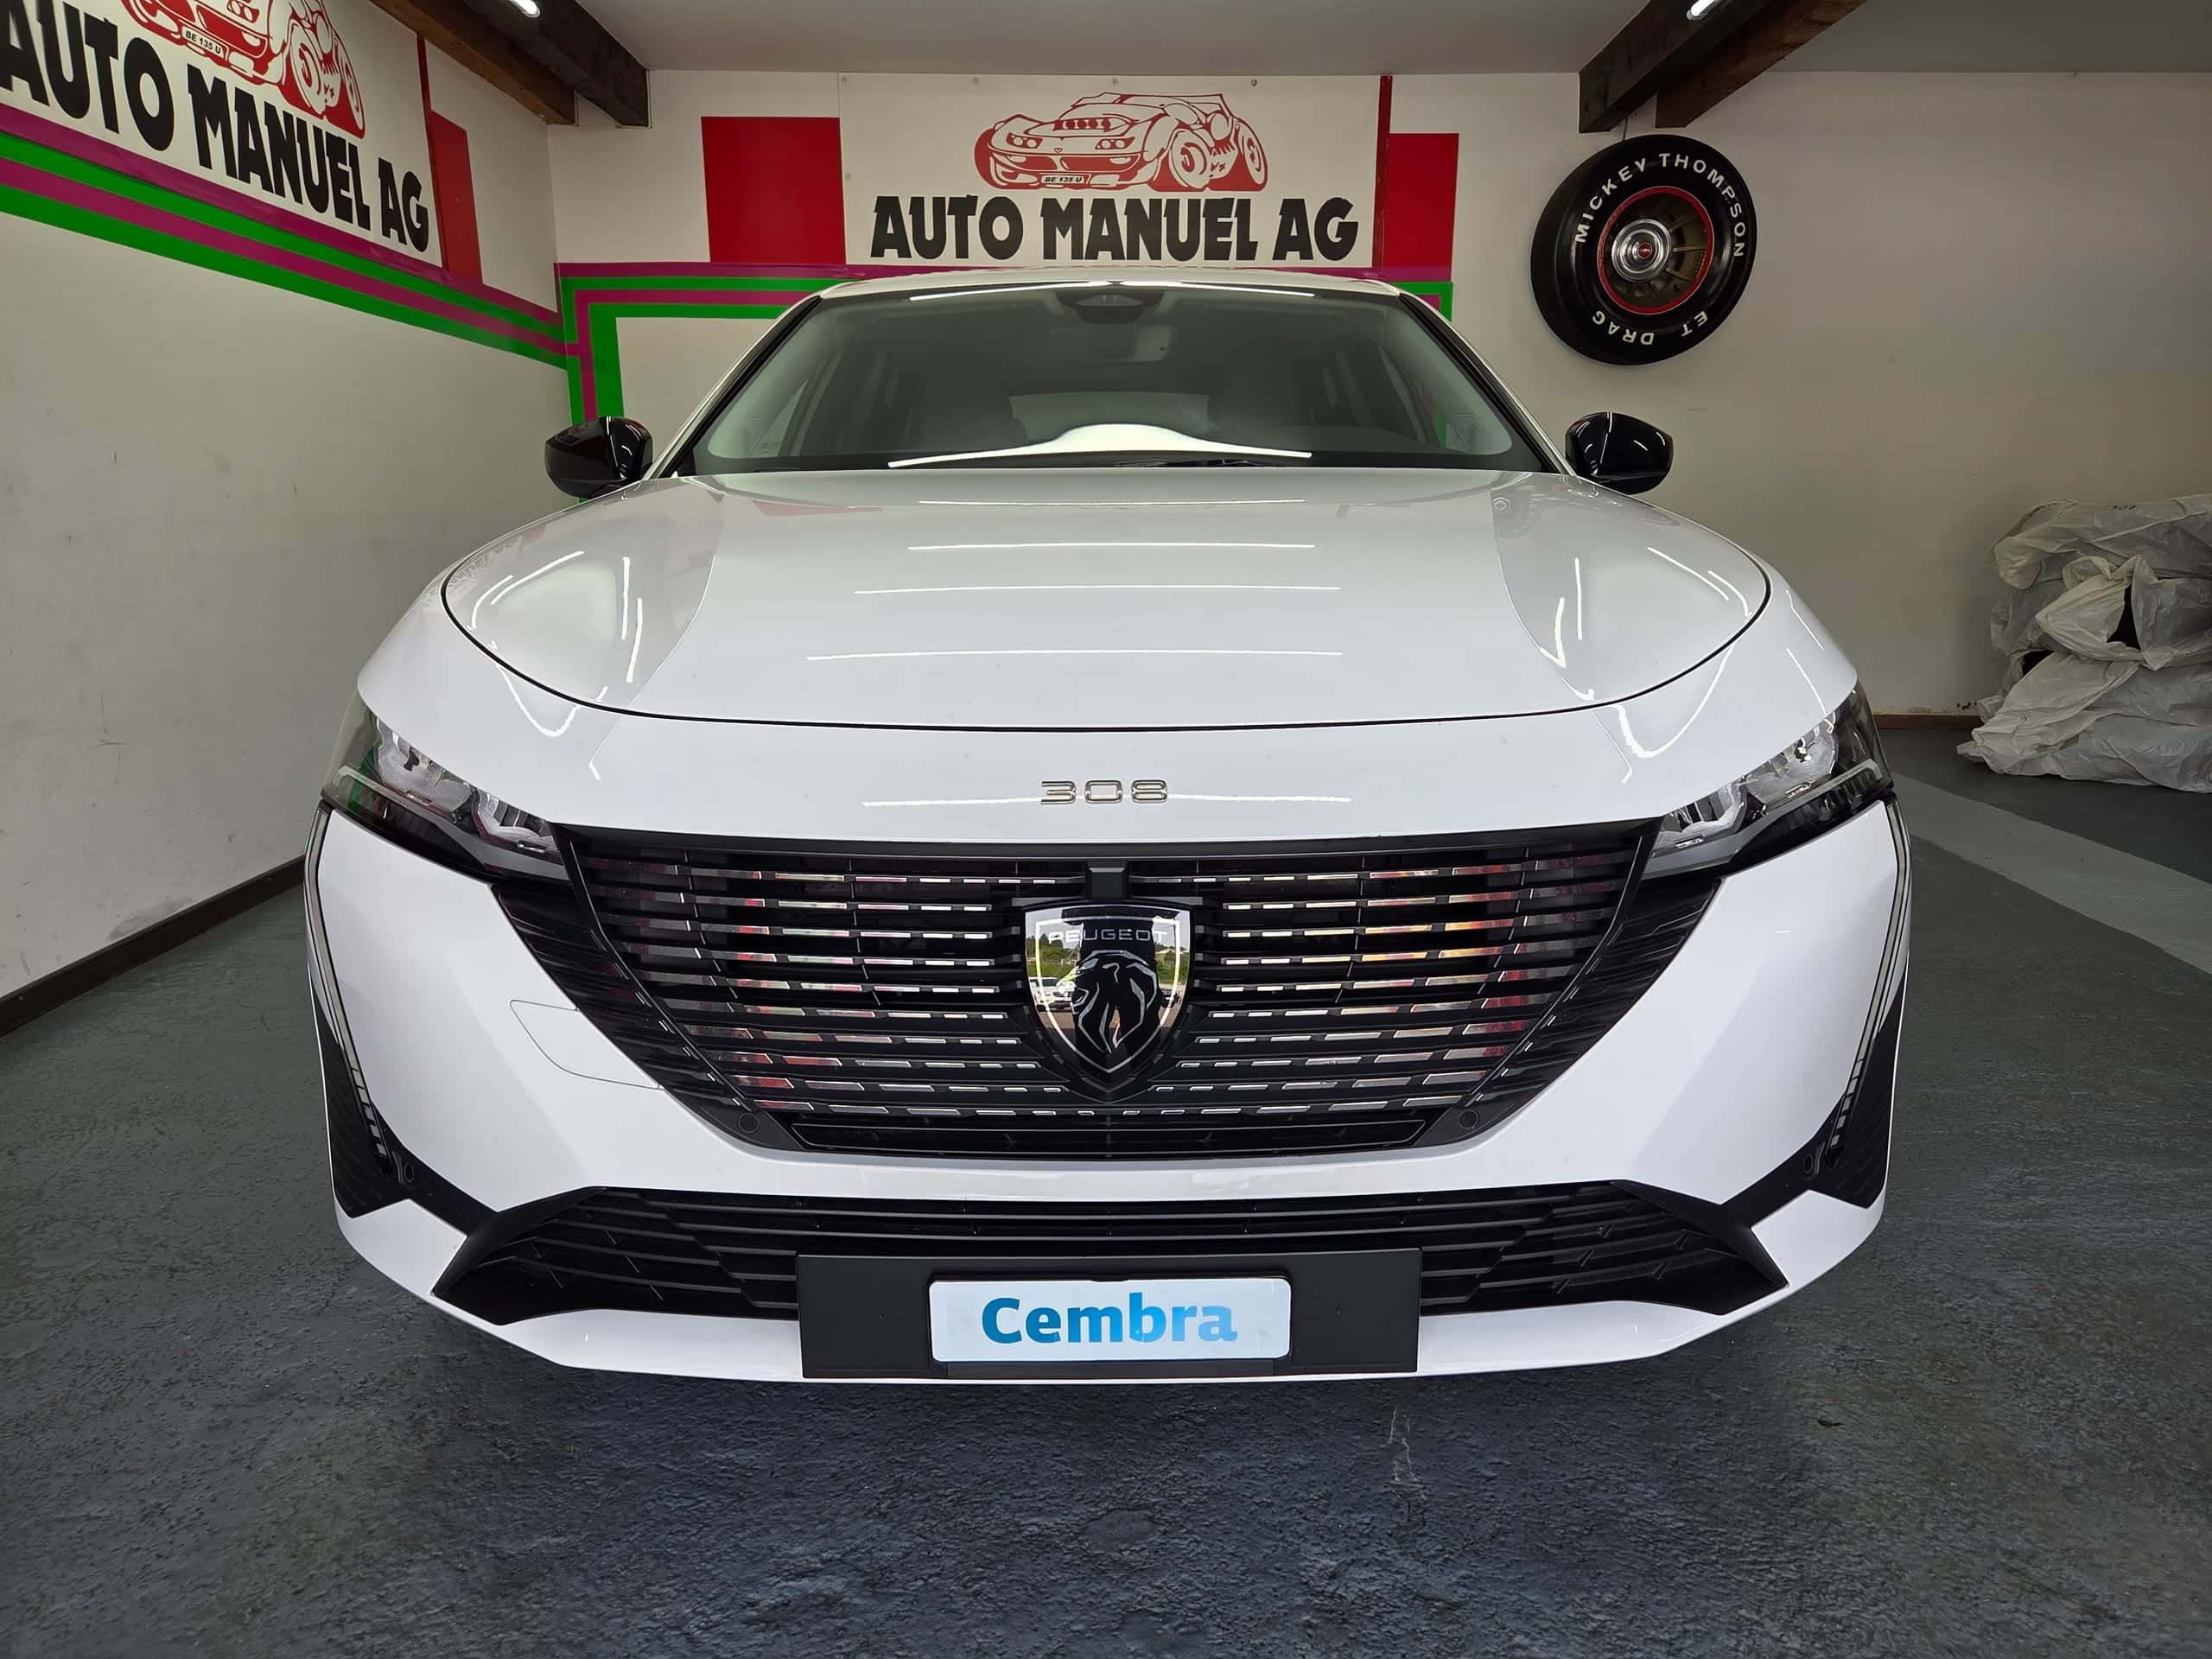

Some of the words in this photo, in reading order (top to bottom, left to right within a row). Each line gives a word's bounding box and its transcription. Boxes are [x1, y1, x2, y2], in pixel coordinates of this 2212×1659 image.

[186, 29, 197, 42] BE
[199, 37, 213, 50] 135
[215, 46, 221, 54] U
[0, 0, 175, 151] AUTO
[188, 63, 371, 231] MANUEL
[378, 157, 429, 253] AG
[1575, 158, 1646, 243] MICKEY
[1659, 153, 1745, 257] THOMPSON
[870, 194, 1024, 258] AUTO
[1039, 198, 1258, 261] MANUEL
[1273, 197, 1358, 261] AG
[1592, 310, 1655, 345] DRAG
[1681, 311, 1708, 337] ET
[1040, 779, 1167, 804] 308
[1048, 928, 1167, 944] PEUGEOT
[982, 1293, 1238, 1344] Cembra
